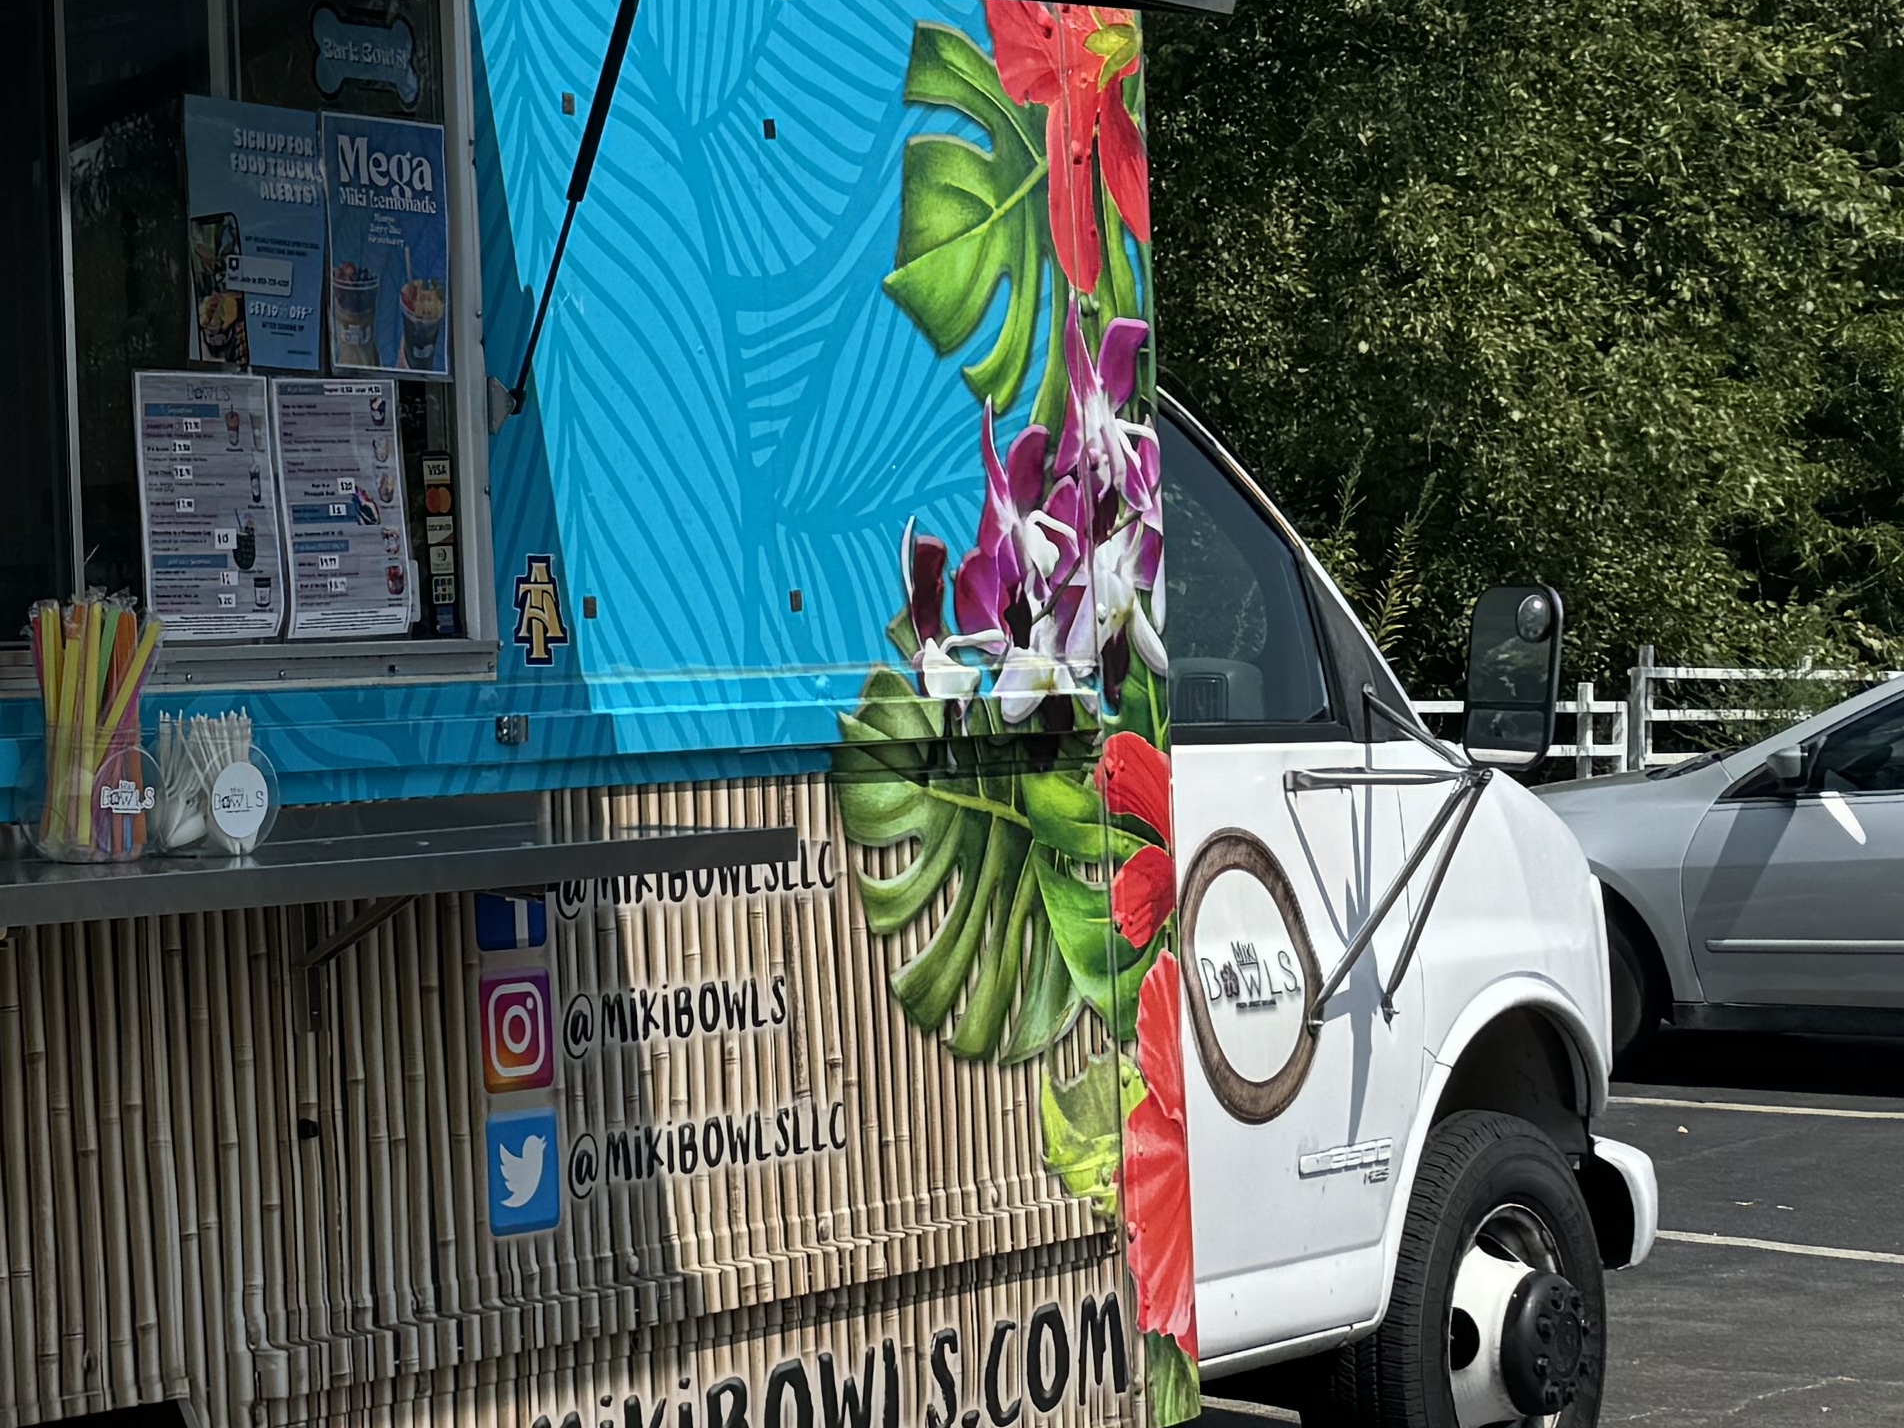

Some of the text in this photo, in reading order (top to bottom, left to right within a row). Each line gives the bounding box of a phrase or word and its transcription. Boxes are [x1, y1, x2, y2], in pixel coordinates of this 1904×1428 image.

[233, 127, 313, 158] SIGN UP FOR
[229, 152, 266, 176] FOOD
[336, 133, 433, 201] Mega
[339, 186, 437, 214] Miki Lemonade
